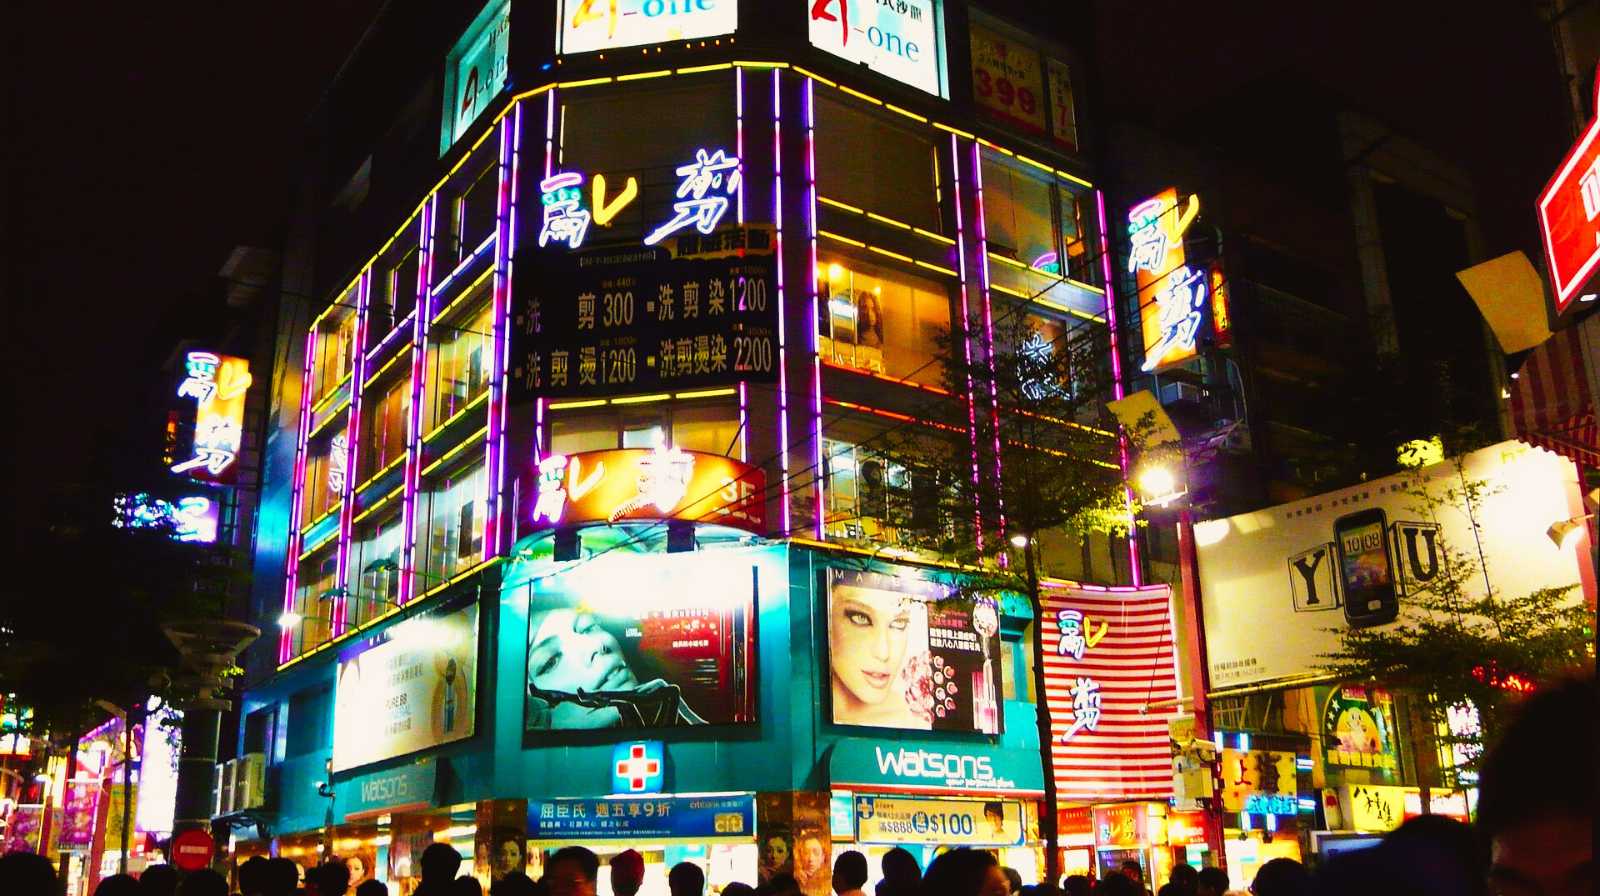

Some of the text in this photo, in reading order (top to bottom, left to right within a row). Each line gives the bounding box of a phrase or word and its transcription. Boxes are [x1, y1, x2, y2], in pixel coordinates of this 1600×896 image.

[603, 291, 634, 327] 300
[729, 276, 767, 312] 1200
[601, 347, 636, 384] 1200
[734, 336, 772, 372] 2200
[875, 746, 994, 780] Watsons
[539, 801, 672, 819] 屈臣氏 週五享9折
[930, 812, 973, 836] $100
